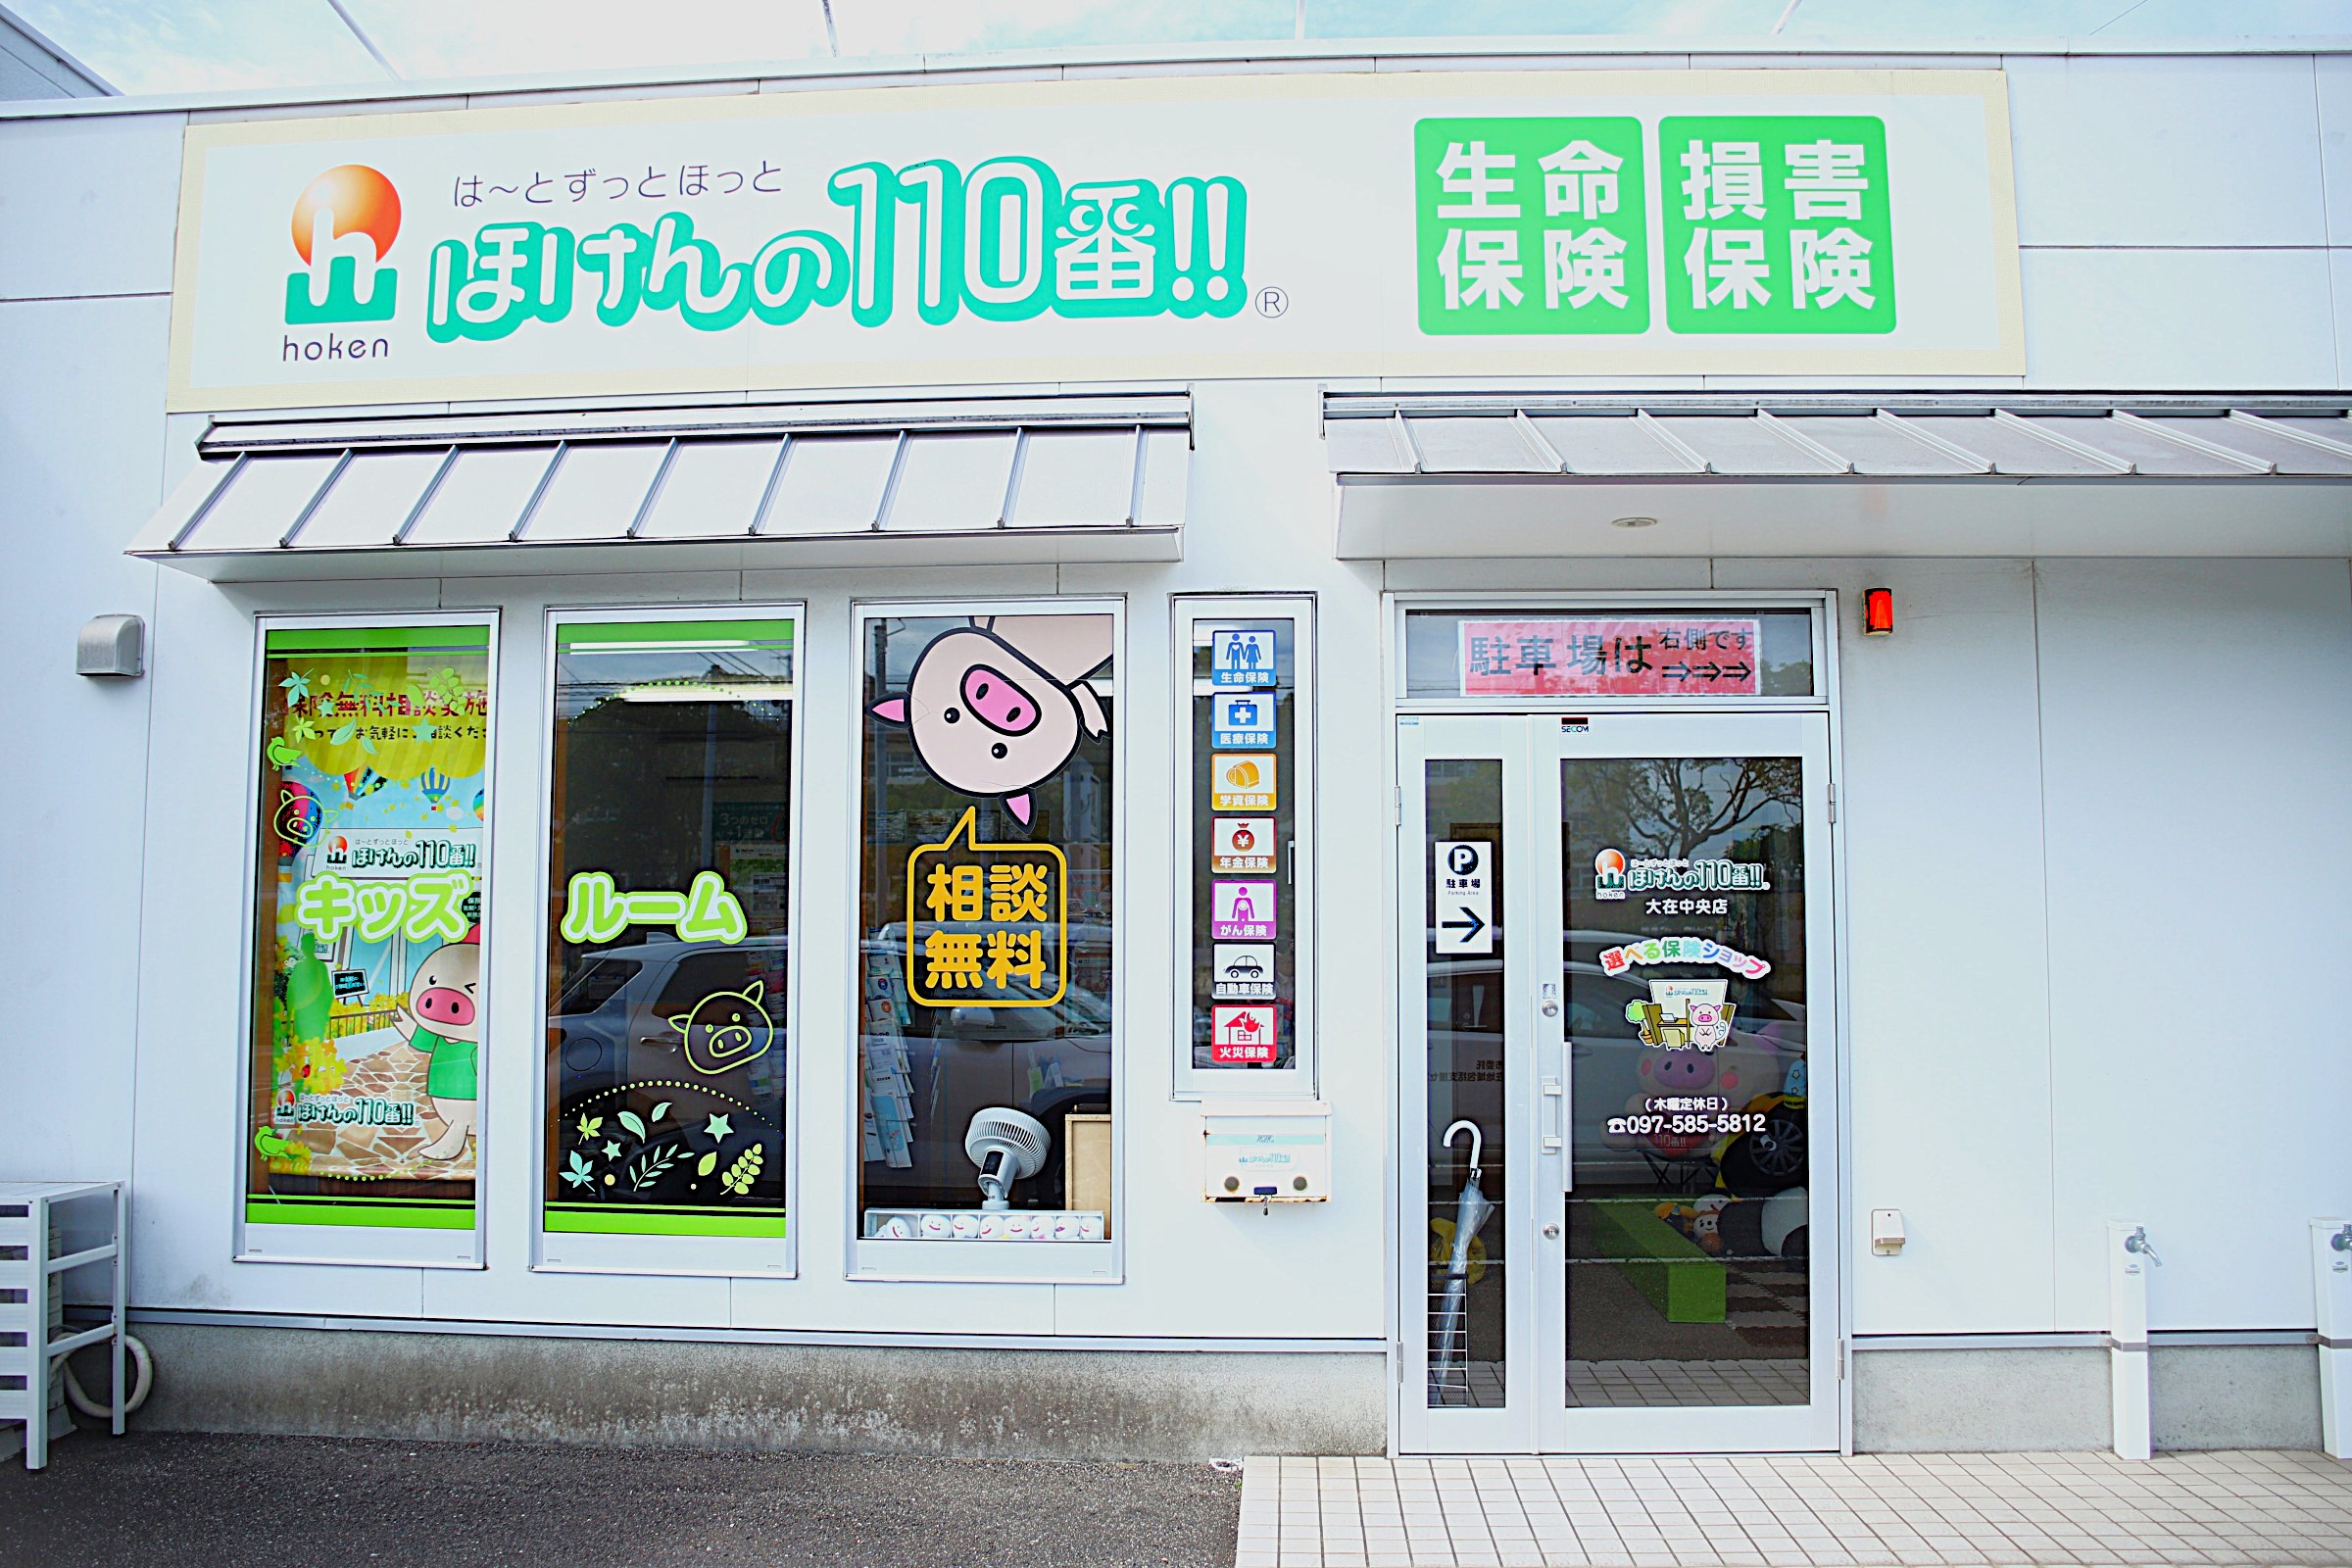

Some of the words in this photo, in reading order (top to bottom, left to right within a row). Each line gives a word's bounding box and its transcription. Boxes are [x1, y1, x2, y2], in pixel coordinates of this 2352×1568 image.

[1435, 139, 1624, 220] 生命
[1680, 138, 1870, 221] 損害
[426, 156, 1248, 343] ほけんの110番!!
[1436, 226, 1630, 311] 保険
[1683, 226, 1877, 311] 保険
[282, 333, 390, 363] hoken
[1469, 634, 1653, 676] 駐車場は
[1659, 627, 1753, 651] 右側です
[1220, 671, 1270, 684] 生命保険
[1220, 732, 1269, 745] 医療保険
[1220, 795, 1269, 807] 学資保険
[1219, 857, 1269, 869] 年金保険
[926, 863, 1048, 922] 相談
[1446, 878, 1481, 889] 駐車場
[295, 870, 474, 943] キッズ
[561, 871, 748, 944] ルーム
[1645, 899, 1729, 915] 大在中央店
[1220, 924, 1267, 937] がん保険
[925, 929, 1047, 990] 無料
[1602, 940, 1769, 975] 選べる保険ショップ
[1215, 983, 1274, 996] 自動車保険
[1219, 1047, 1269, 1059] 火災保険
[1627, 1113, 1766, 1134] 097-585-5812
